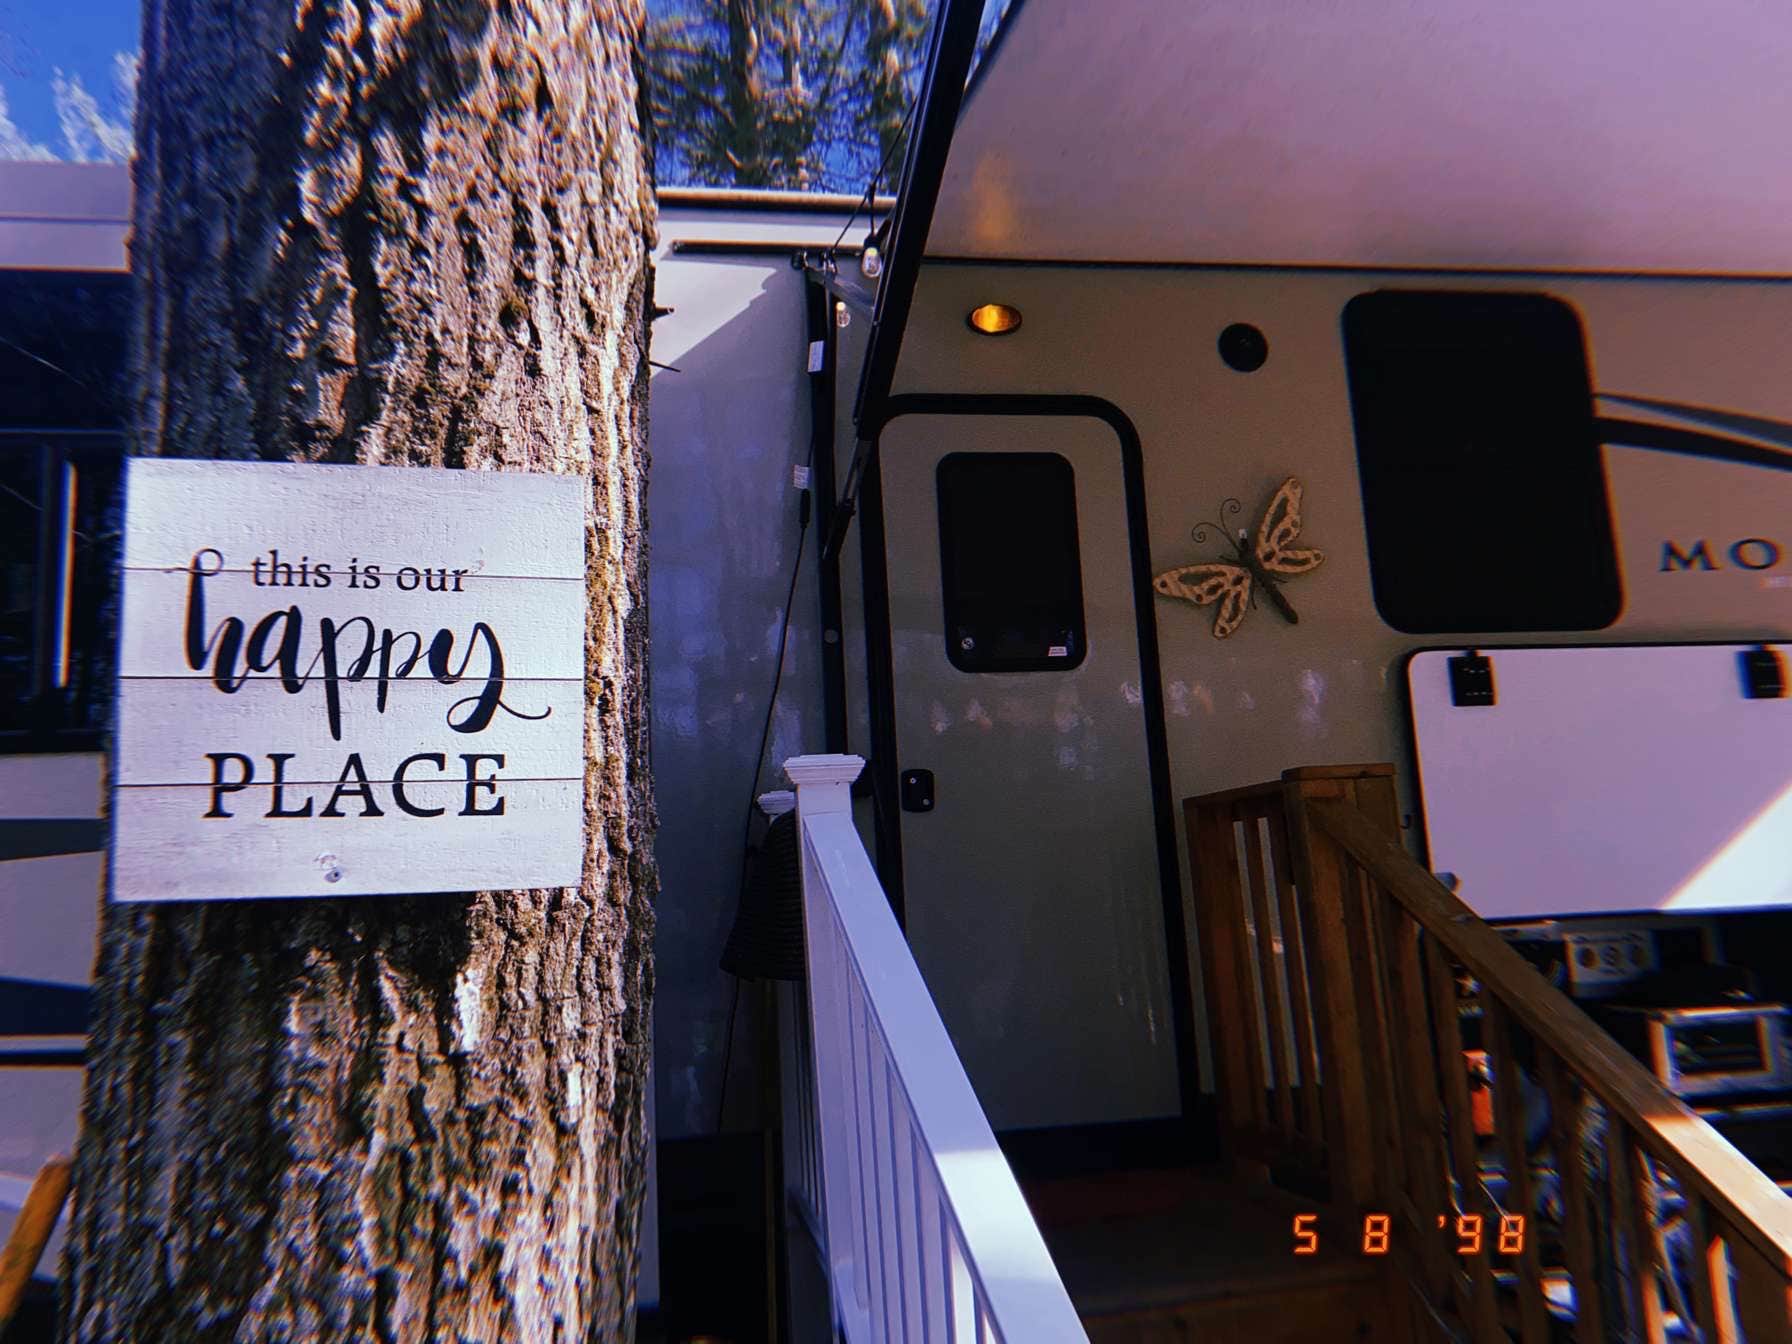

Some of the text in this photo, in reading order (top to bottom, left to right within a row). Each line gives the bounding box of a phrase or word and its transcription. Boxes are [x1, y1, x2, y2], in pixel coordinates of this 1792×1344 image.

[251, 550, 470, 592] this is our
[166, 548, 551, 741] happy
[203, 752, 506, 818] PLACE
